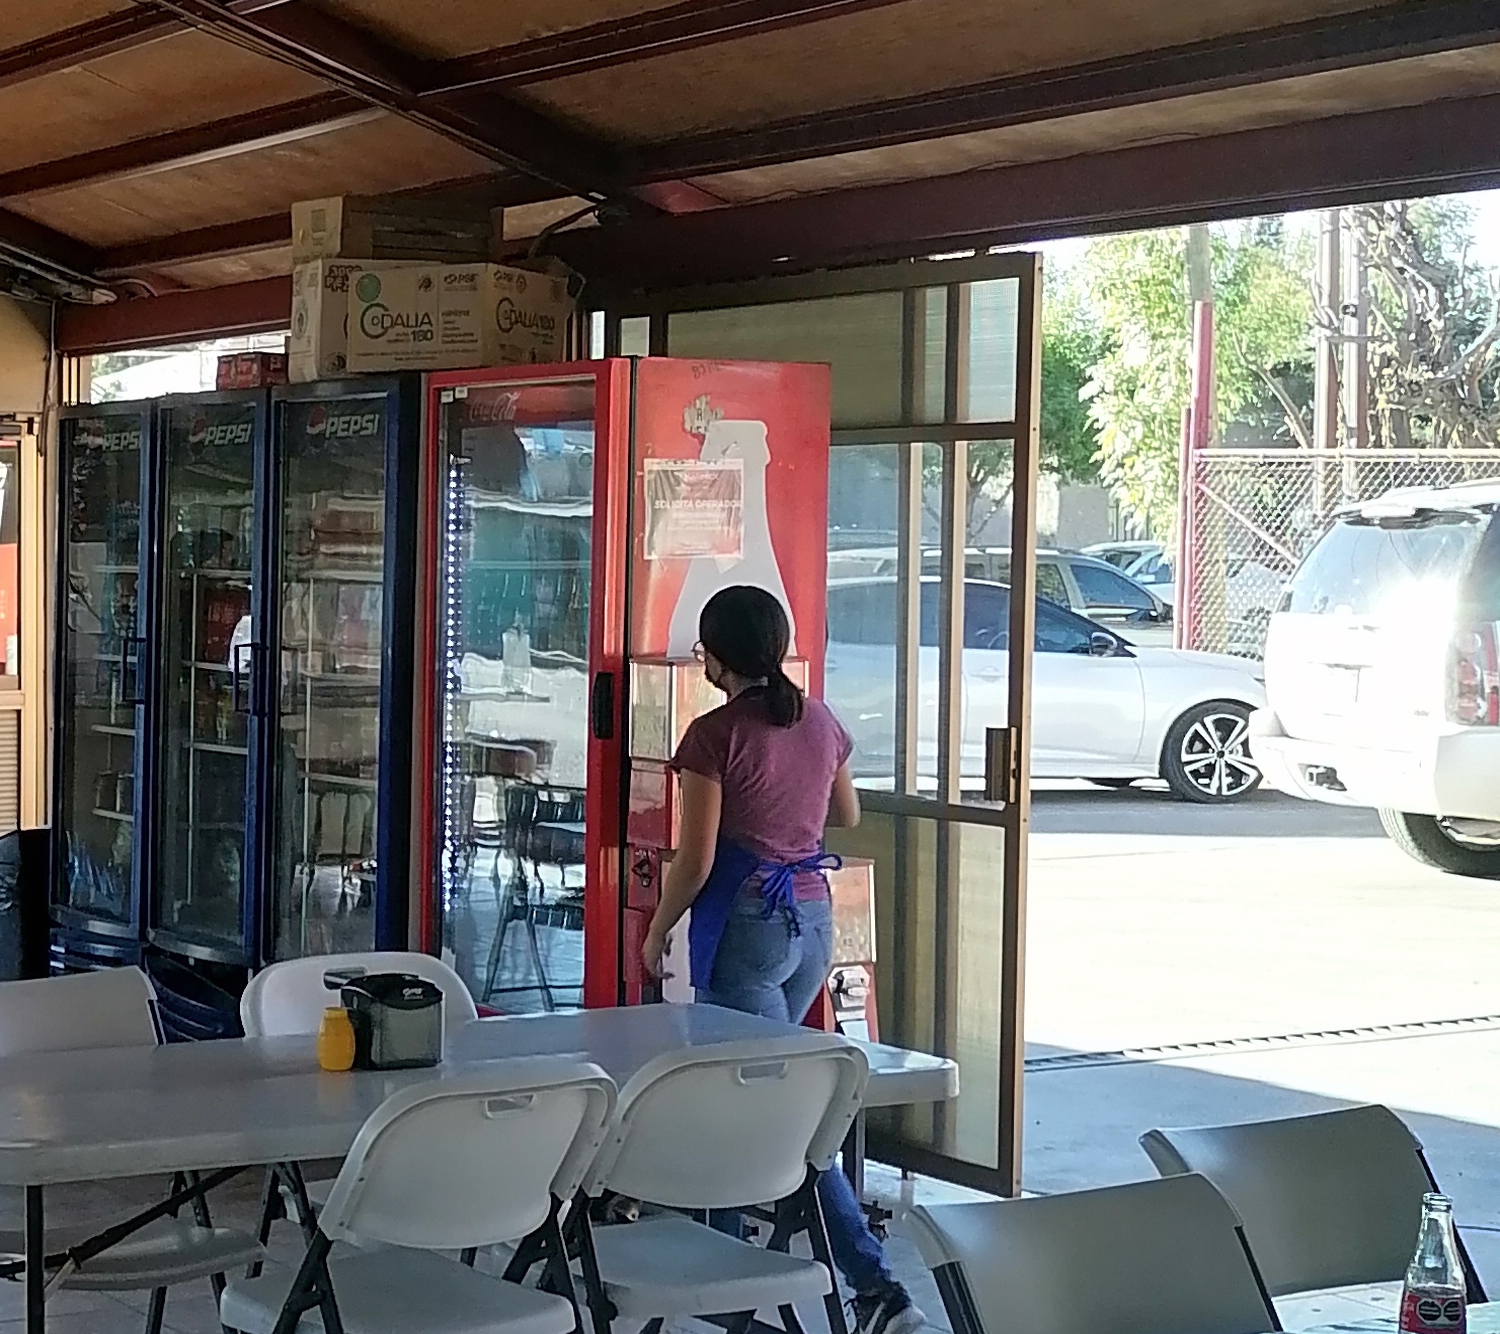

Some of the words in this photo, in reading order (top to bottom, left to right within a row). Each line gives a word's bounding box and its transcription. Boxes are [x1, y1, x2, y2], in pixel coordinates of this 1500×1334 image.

[204, 423, 252, 446] PEPSI
[324, 413, 379, 438] PEPSI
[102, 431, 140, 451] PEPS
